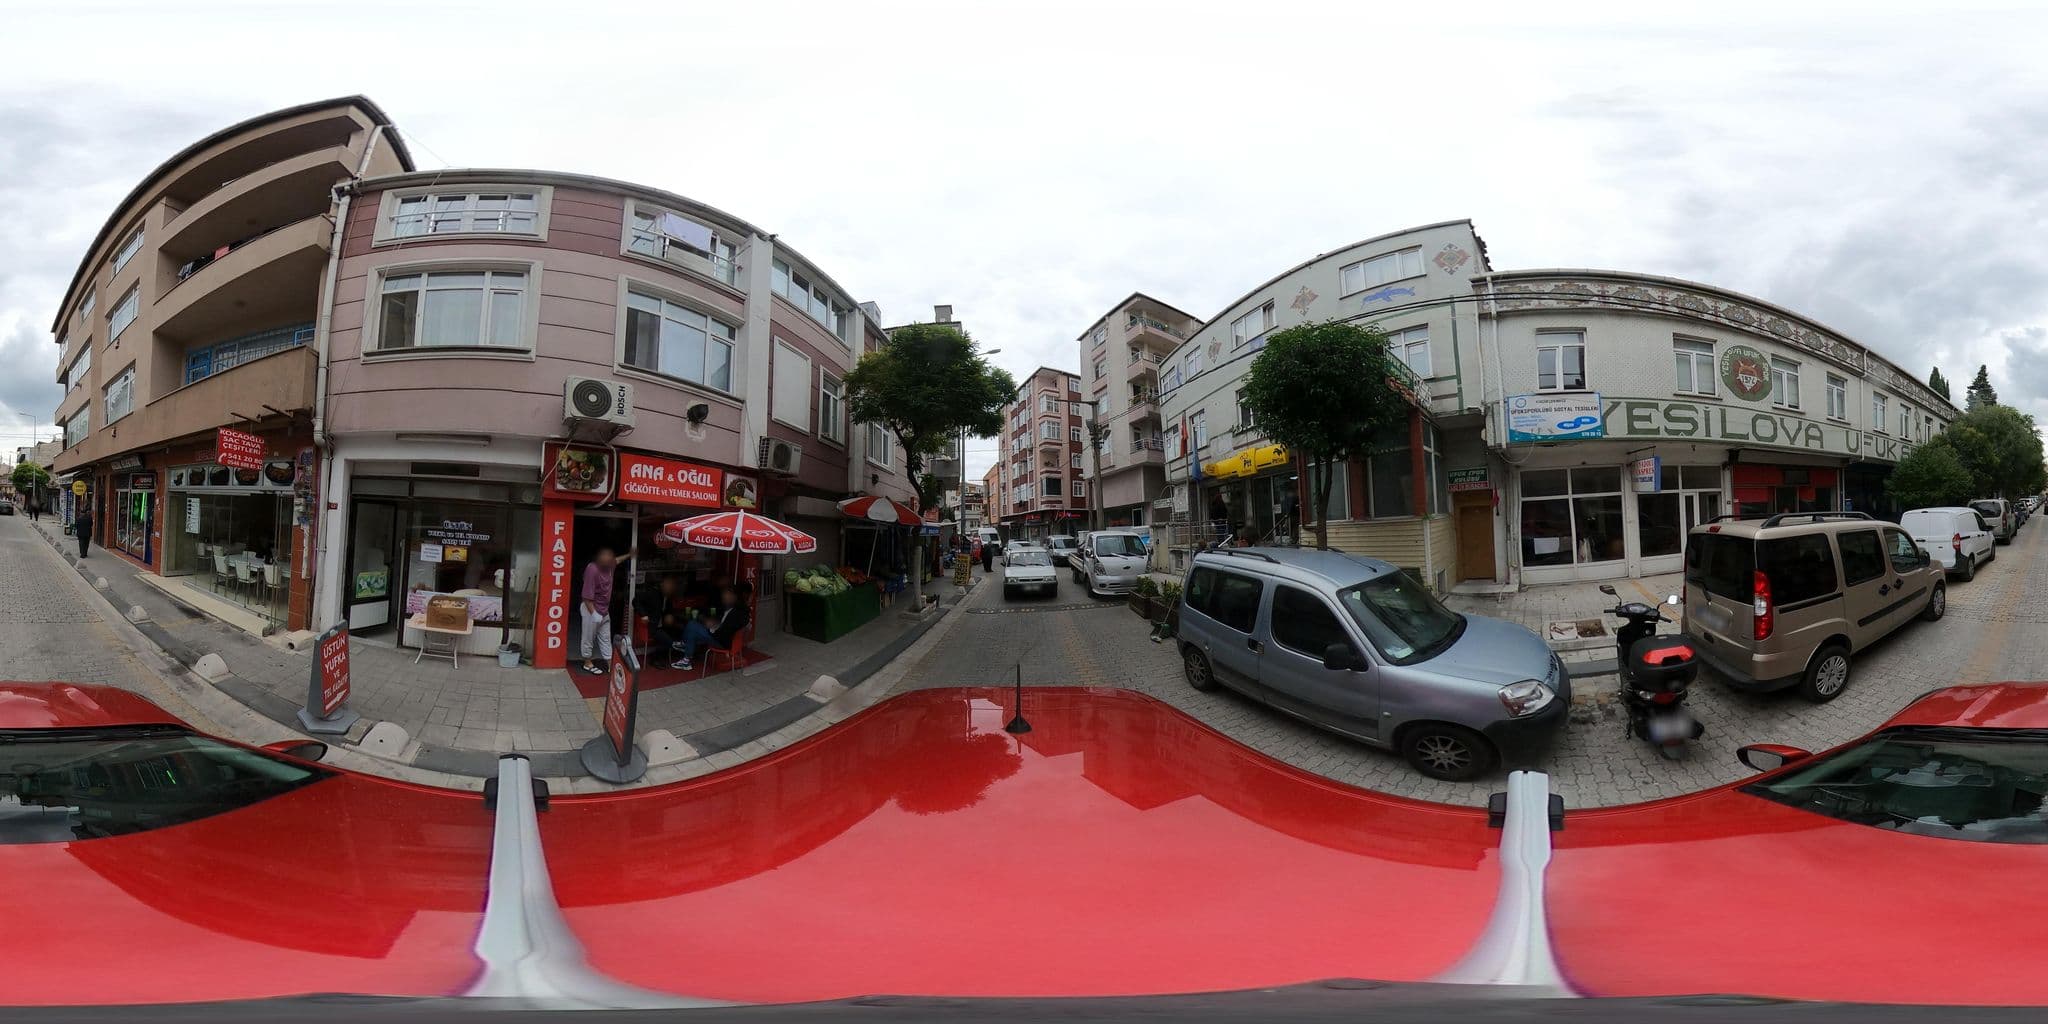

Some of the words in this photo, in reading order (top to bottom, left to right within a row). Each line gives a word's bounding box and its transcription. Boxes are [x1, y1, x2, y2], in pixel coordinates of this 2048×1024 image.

[617, 385, 626, 415] BOSCH
[220, 429, 264, 443] KOCAOĞLU
[224, 436, 239, 444] SAC
[241, 440, 261, 449] TAVA
[630, 464, 664, 481] ANA
[677, 469, 713, 486] OĞUL
[624, 482, 660, 495] ÇİĞKÖFTE
[669, 488, 691, 498] YEMEK
[692, 492, 717, 502] SALONU
[323, 636, 345, 658] ÜSTÜN
[325, 652, 346, 674] YUFKA
